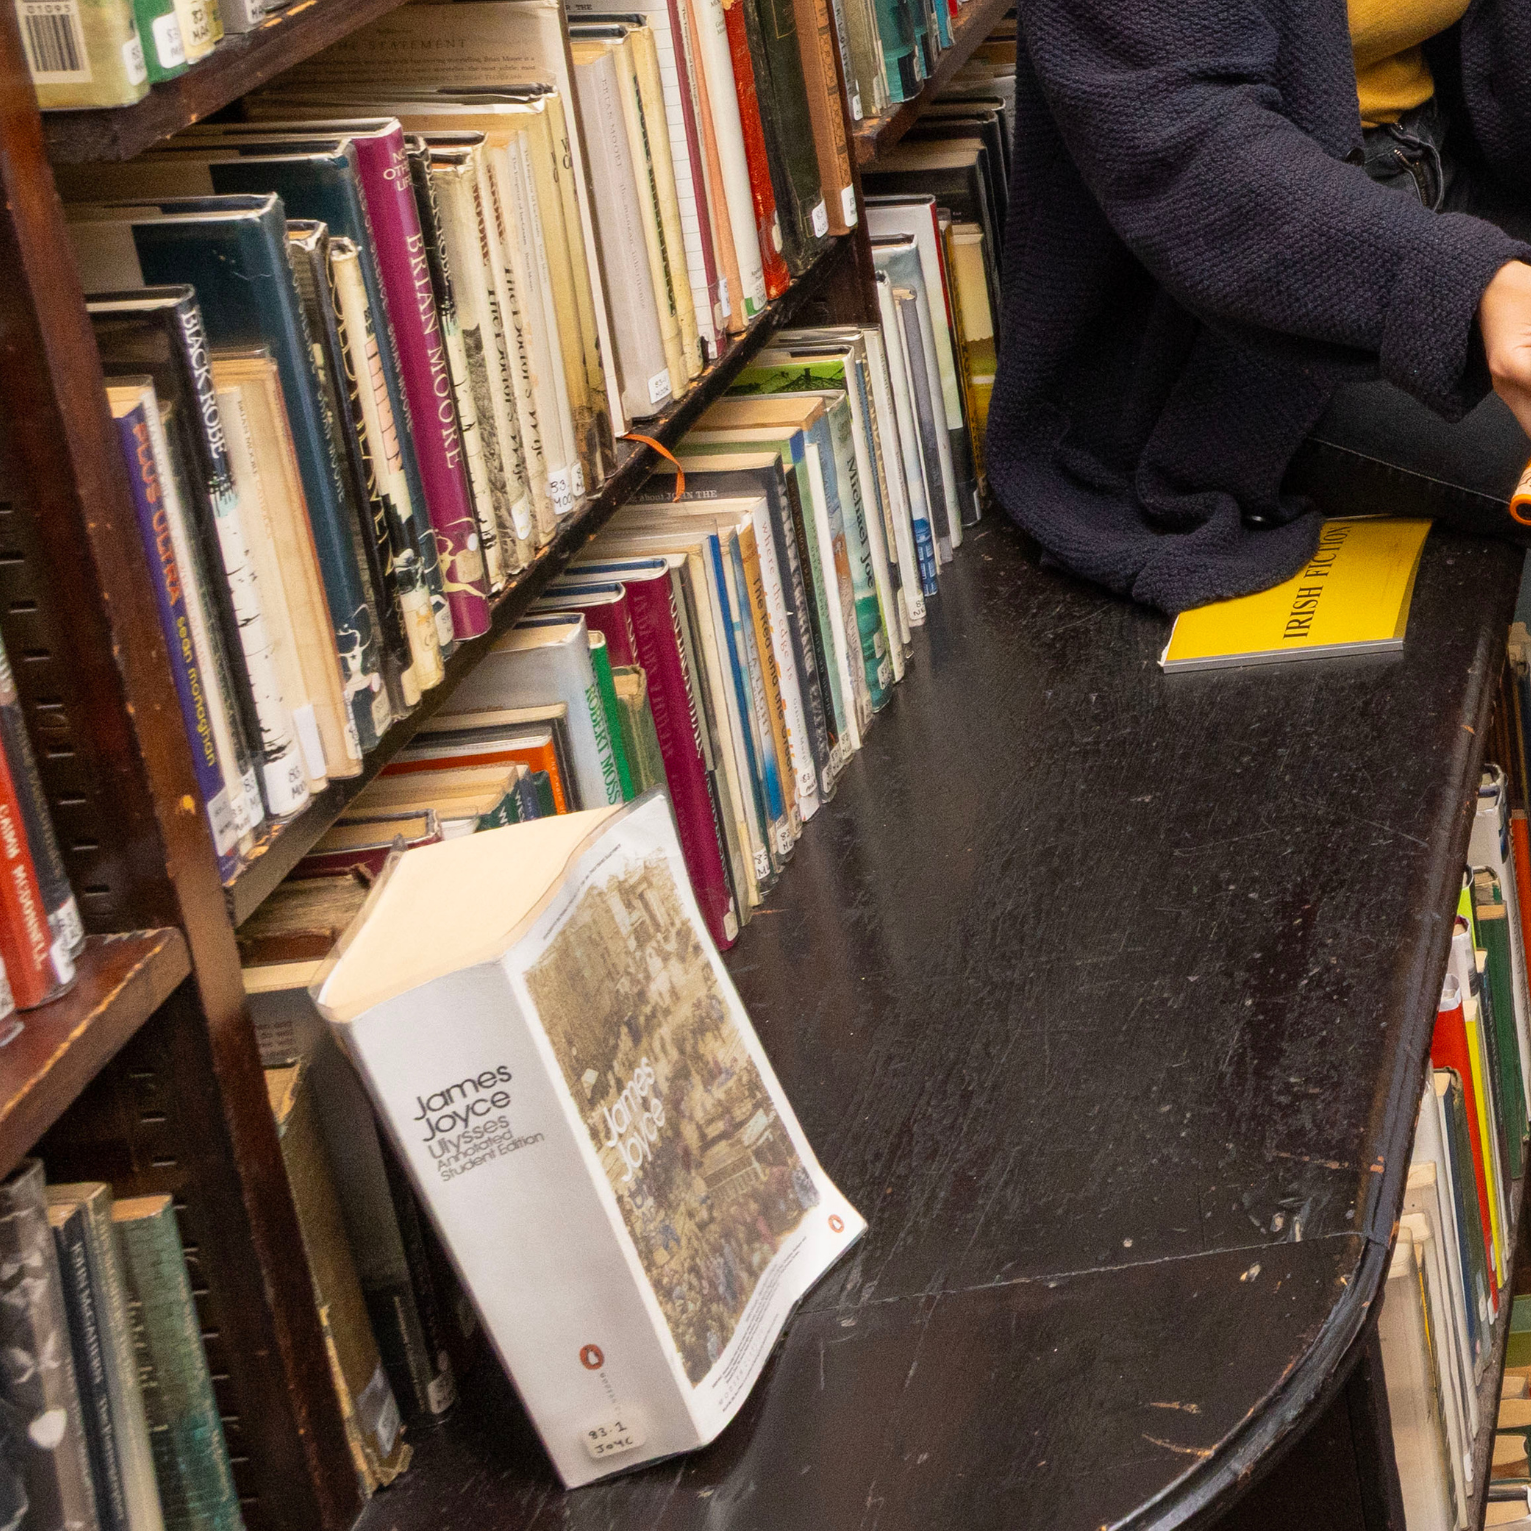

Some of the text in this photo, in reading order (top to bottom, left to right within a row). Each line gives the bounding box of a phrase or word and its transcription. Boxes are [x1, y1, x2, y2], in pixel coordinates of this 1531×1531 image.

[406, 233, 463, 471] BRIAN MOORE
[150, 503, 179, 608] ULTRA
[1283, 526, 1350, 640] IRISH FICTION
[186, 666, 218, 768] monaghan
[584, 685, 622, 806] ROBERT MOSS
[413, 1064, 512, 1123] James
[421, 1087, 512, 1146] Joyce
[427, 1112, 511, 1162] Ulysses
[599, 1055, 657, 1149] James
[436, 1129, 513, 1172] Annotated
[440, 1131, 545, 1183] Student Edition
[617, 1098, 666, 1183] Joyce
